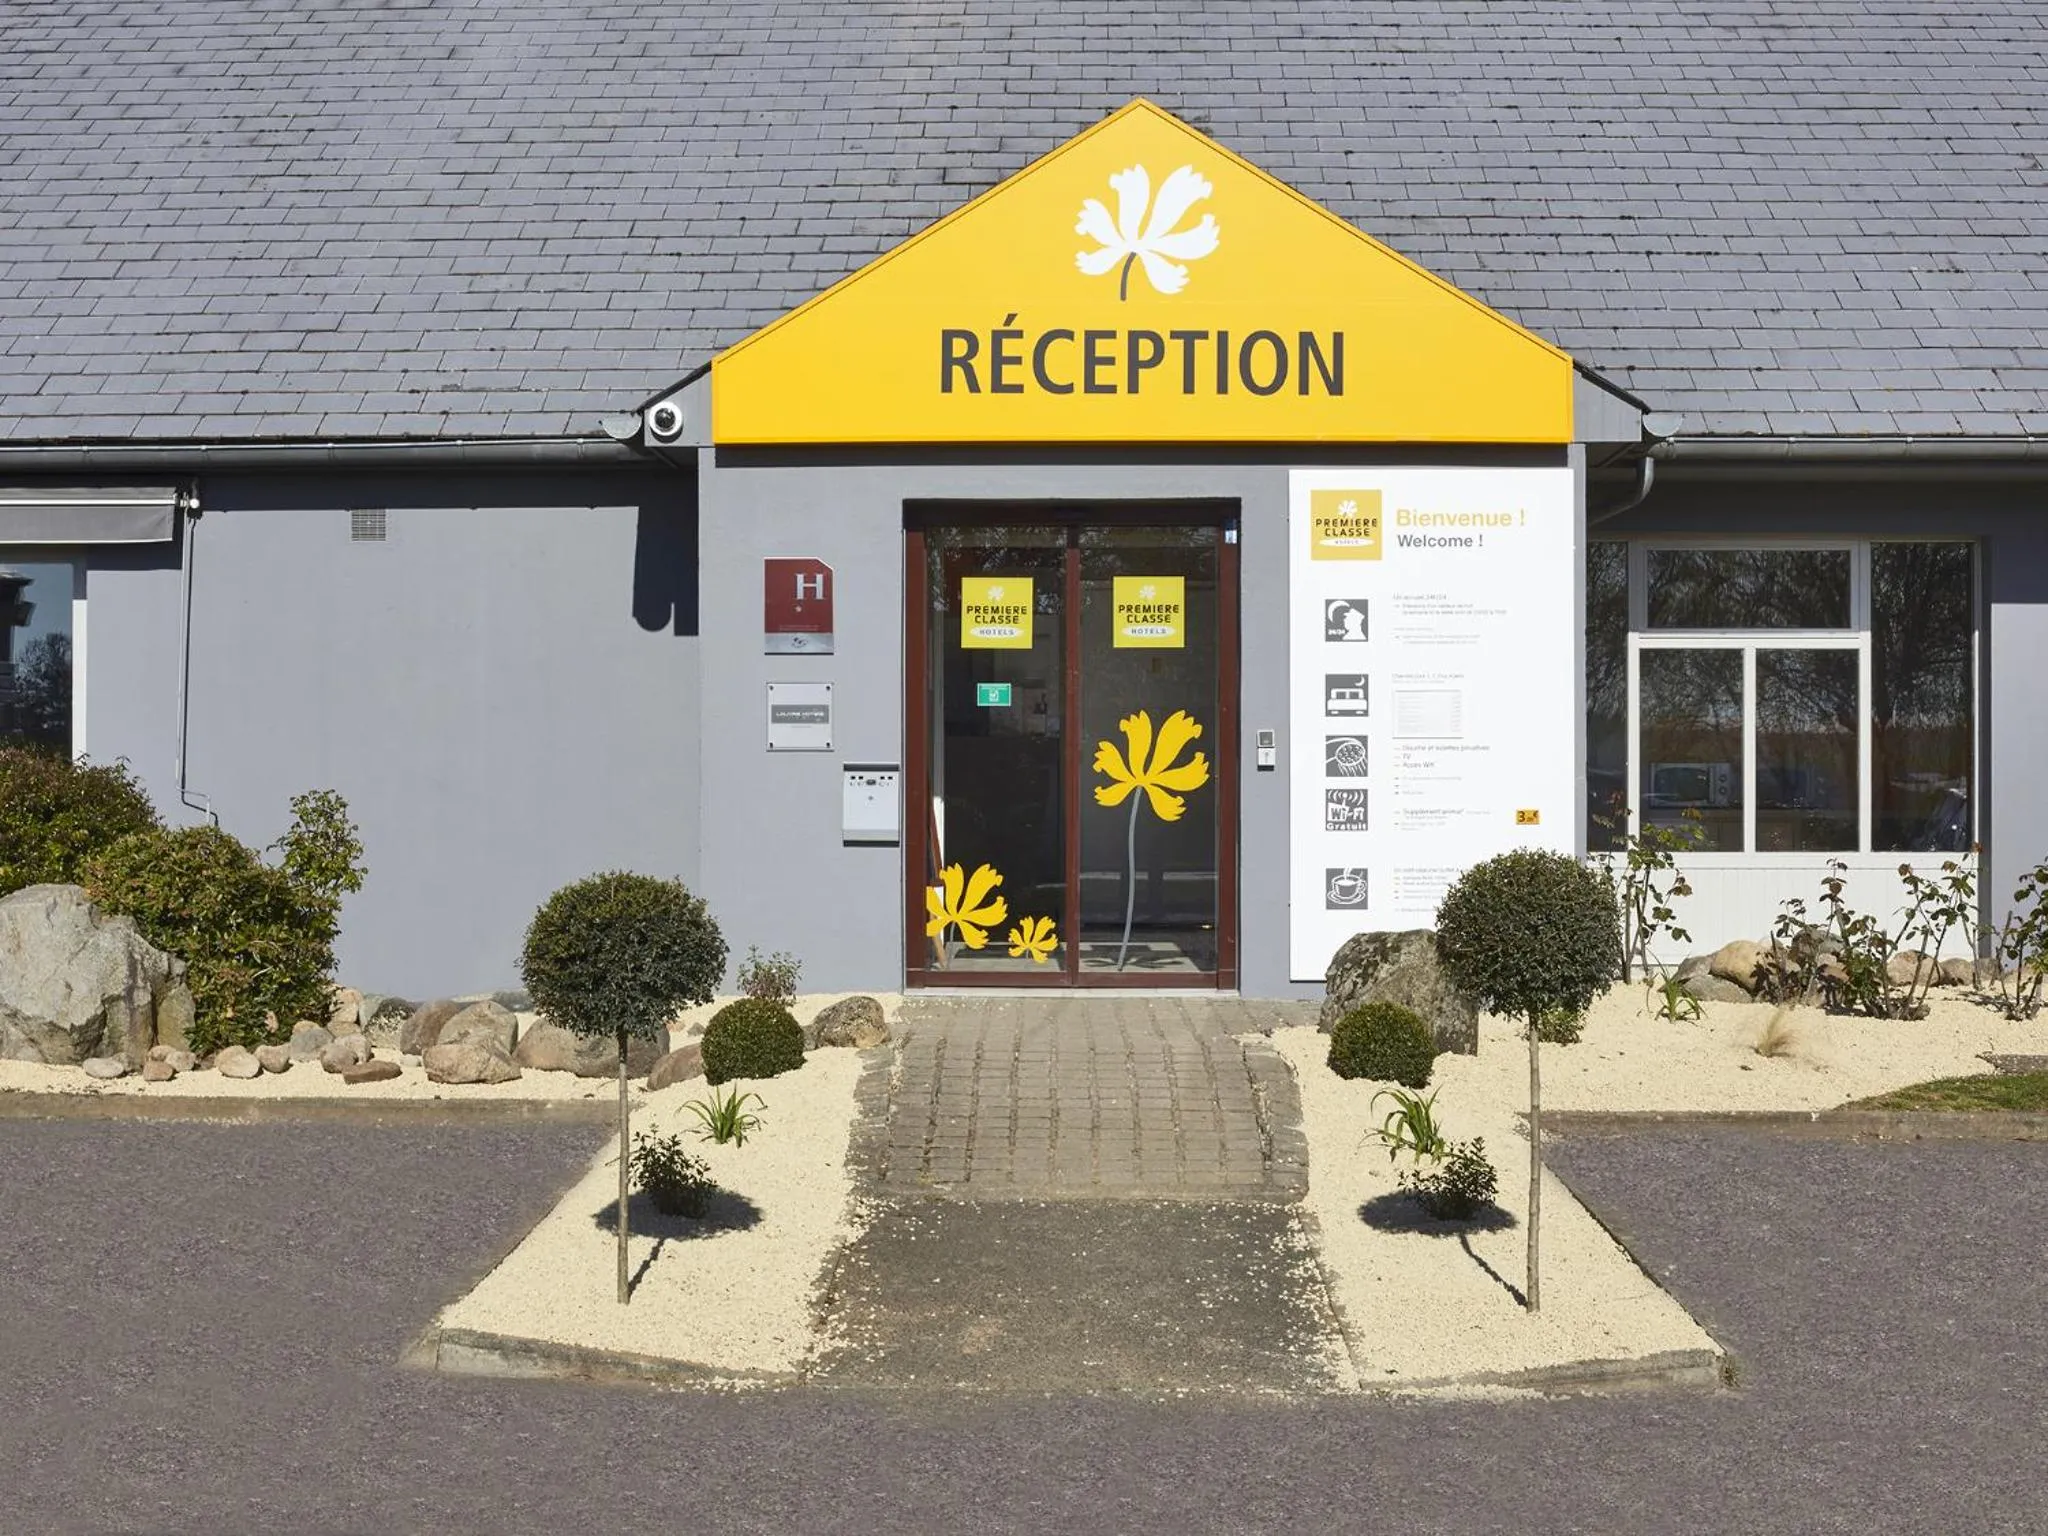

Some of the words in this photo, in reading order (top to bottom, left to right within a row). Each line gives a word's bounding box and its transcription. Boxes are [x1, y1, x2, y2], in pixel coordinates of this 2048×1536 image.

[940, 313, 1345, 396] RÉCEPTION
[1396, 509, 1513, 526] Bienvenue
[1315, 518, 1377, 528] PREMIERE
[1325, 528, 1370, 537] CLASSE
[1397, 534, 1473, 548] Welcome
[796, 573, 823, 600] H
[966, 605, 1028, 615] PREMIERE
[1118, 604, 1180, 614] PREMIERE
[974, 615, 1020, 625] CLASSE
[1126, 614, 1171, 624] CLASSE
